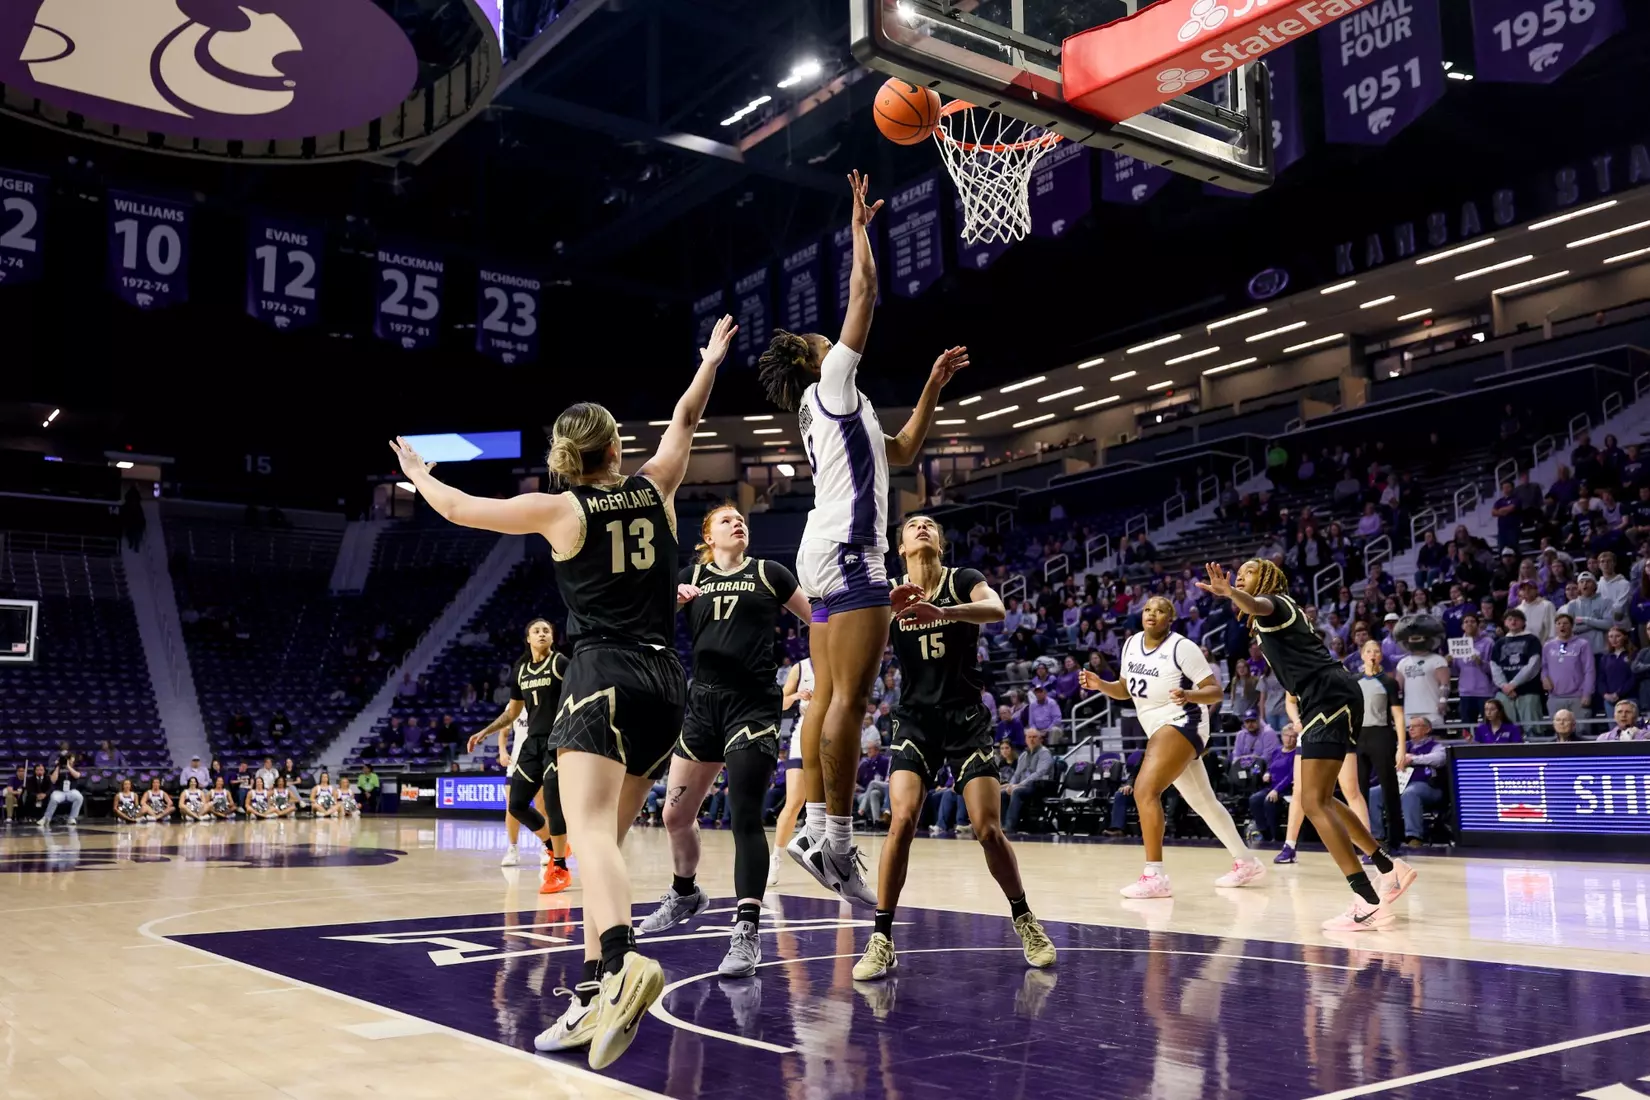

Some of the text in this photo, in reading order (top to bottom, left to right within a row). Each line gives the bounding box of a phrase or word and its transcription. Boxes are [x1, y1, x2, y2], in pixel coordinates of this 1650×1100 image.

[1201, 17, 1306, 71] State
[1297, 0, 1364, 25] Fa
[1340, 0, 1413, 43] FINAL
[1493, 0, 1597, 52] 1958
[1340, 16, 1413, 66] FOUR
[1343, 56, 1422, 115] 1951
[891, 179, 935, 208] K-STATE
[0, 196, 38, 252] 2
[113, 198, 185, 223] WILLIAMS
[265, 227, 309, 247] EVANS
[1334, 188, 1515, 275] KANSAS
[114, 217, 182, 276] 10
[255, 244, 316, 301] 12
[377, 250, 444, 273] BLACKMAN
[121, 276, 170, 293] 1972-76
[479, 269, 541, 291] RICHMOND
[380, 268, 440, 321] 25
[482, 286, 537, 337] 23
[244, 453, 273, 475] 15
[606, 517, 656, 574] 13
[699, 581, 756, 597] COLORADO
[712, 595, 740, 621] 17
[899, 617, 958, 632] COLORAD
[917, 632, 946, 660] 15
[1127, 661, 1160, 678] Wildcats
[531, 689, 539, 706] 1
[1129, 677, 1148, 699] 22
[457, 783, 496, 802] SHELTER
